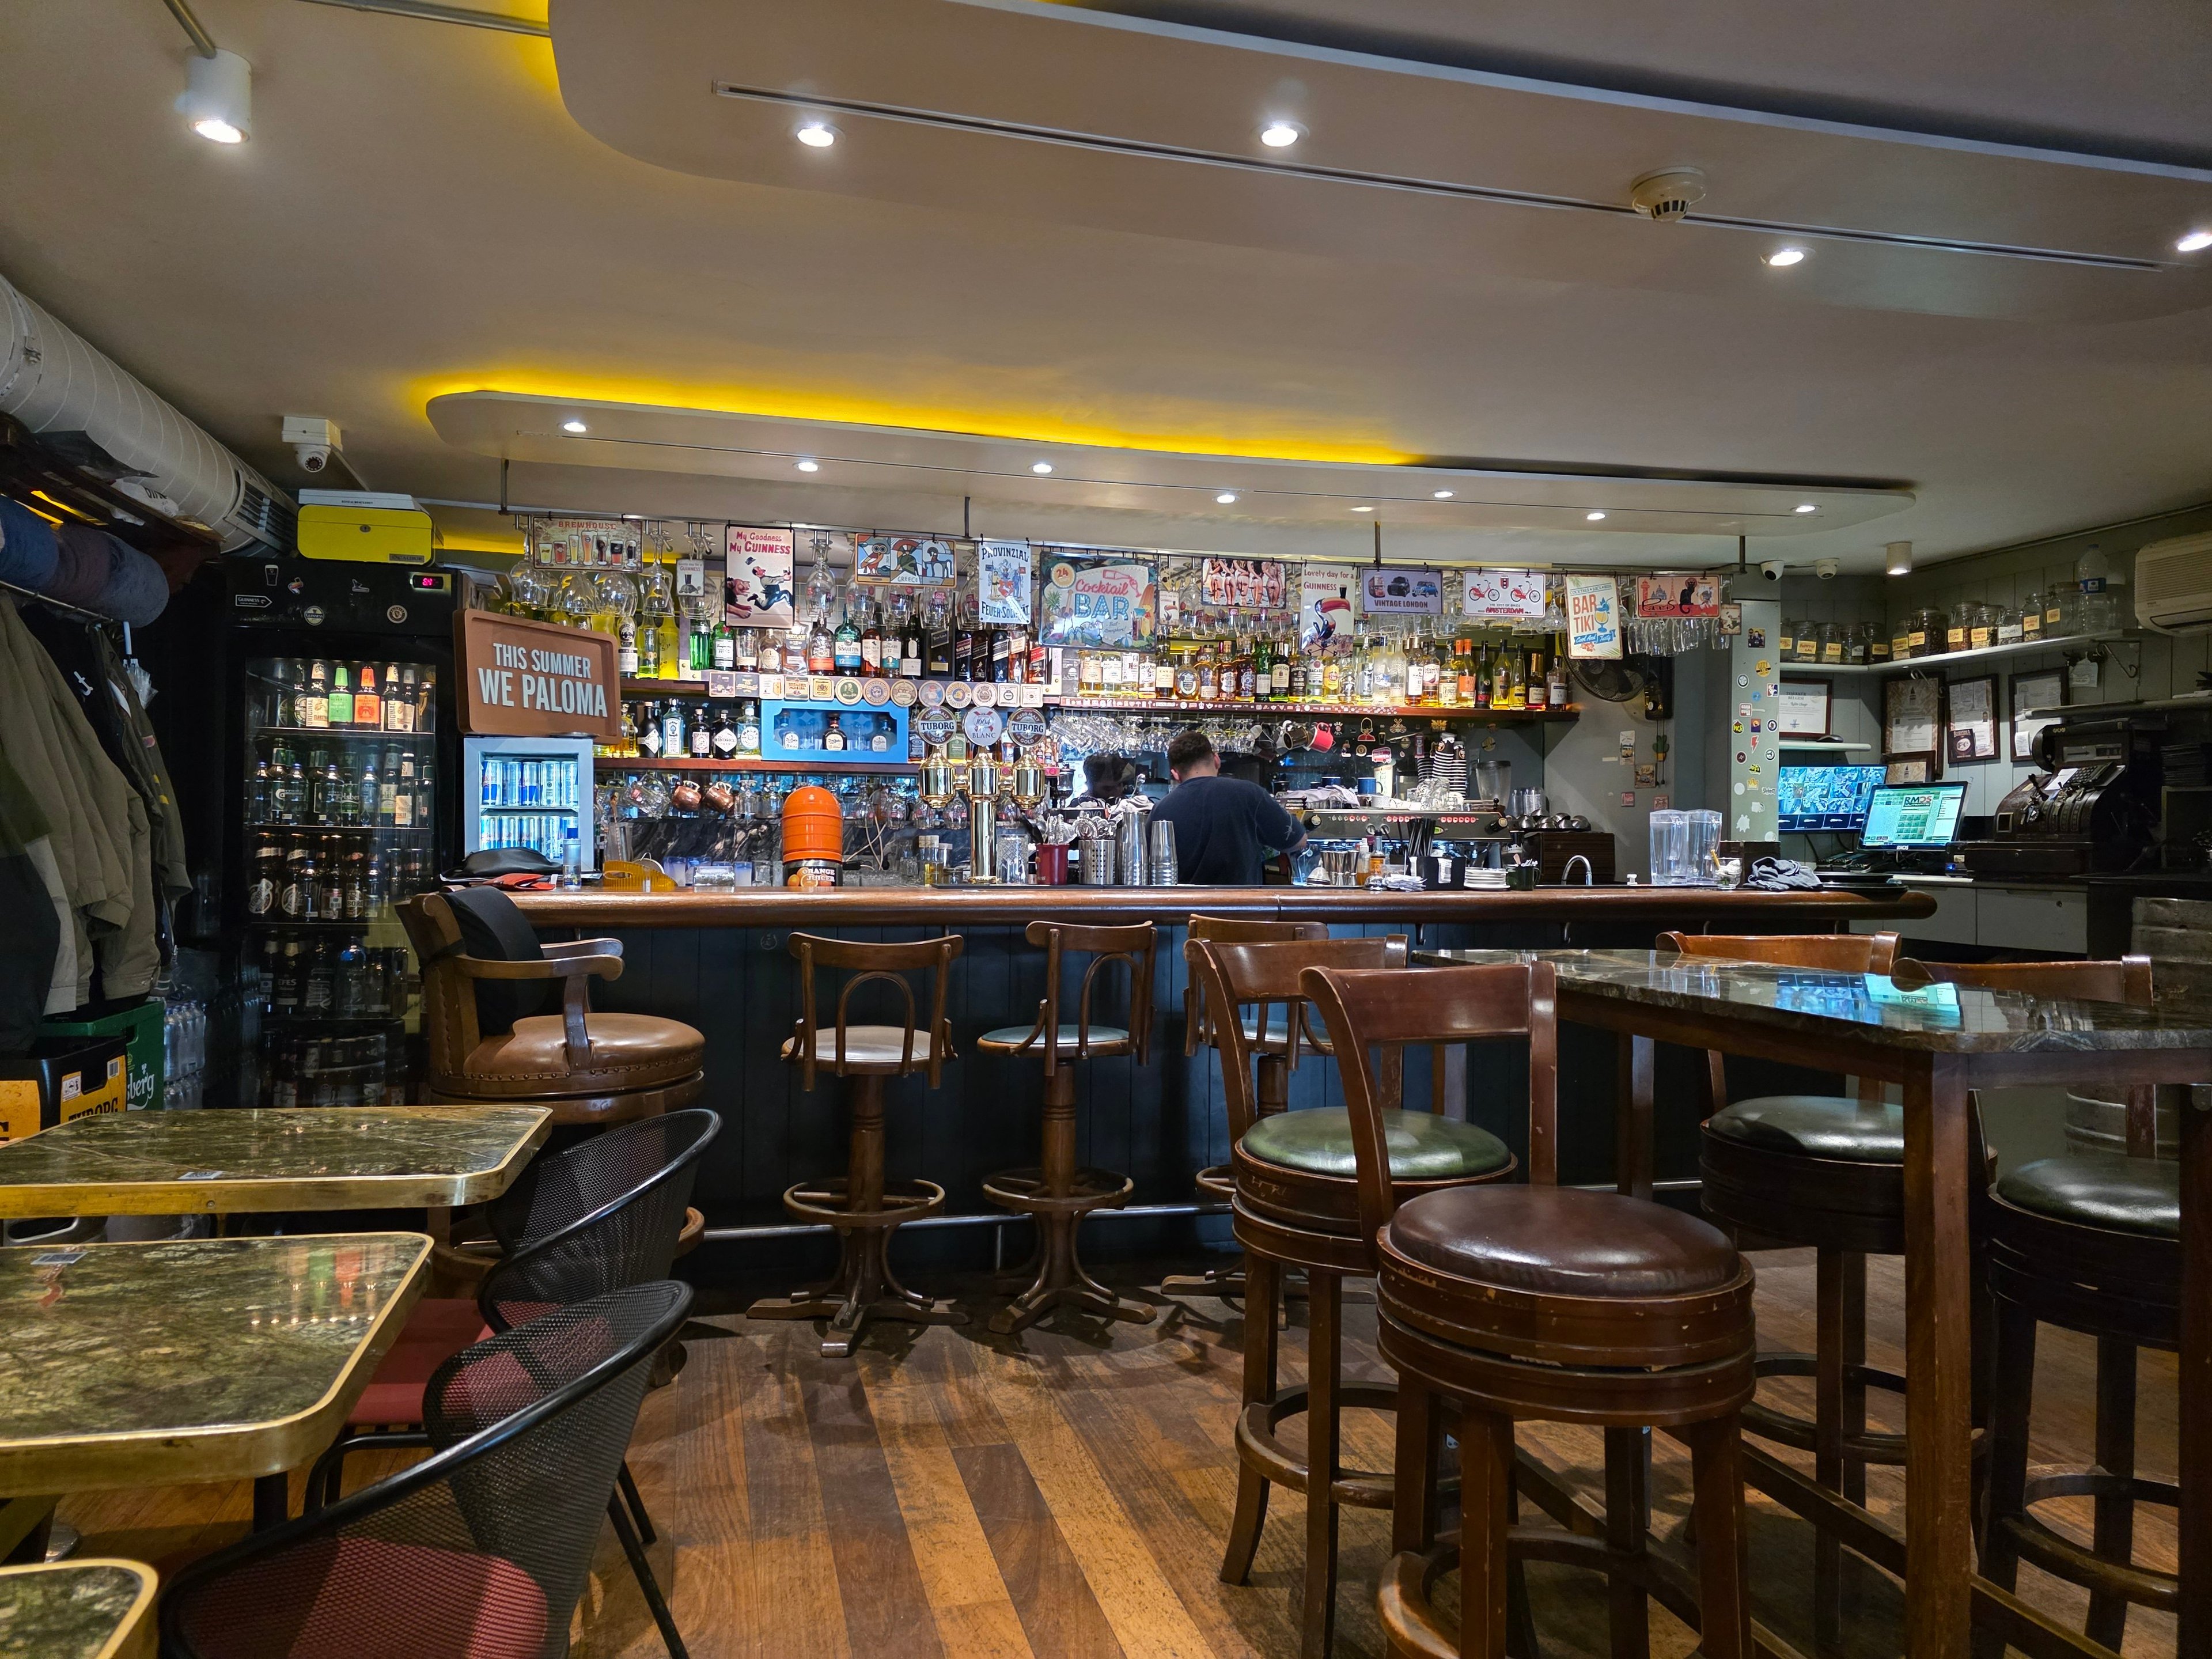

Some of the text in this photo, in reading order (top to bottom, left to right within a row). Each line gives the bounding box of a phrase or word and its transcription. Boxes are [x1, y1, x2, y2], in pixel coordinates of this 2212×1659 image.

[558, 521, 616, 529] BREWHOUSE
[736, 531, 782, 542] My Goodness
[729, 541, 791, 555] My GUINNESS
[1056, 569, 1069, 578] 24
[1304, 569, 1325, 578] Lovely
[1327, 571, 1339, 579] day
[1340, 570, 1349, 578] for
[1075, 579, 1129, 596] Cocktail
[1304, 581, 1337, 591] GUINNESS
[1074, 593, 1130, 620] BAR
[1573, 594, 1597, 615] BAR
[1642, 597, 1675, 612] Paris
[1573, 615, 1594, 633] TIKI
[493, 643, 591, 679] THIS SUMMER
[478, 668, 608, 717] WE PALOMA
[921, 722, 955, 730] TUBORG
[1012, 723, 1044, 733] TUBORG
[1904, 796, 1932, 804] RMOS
